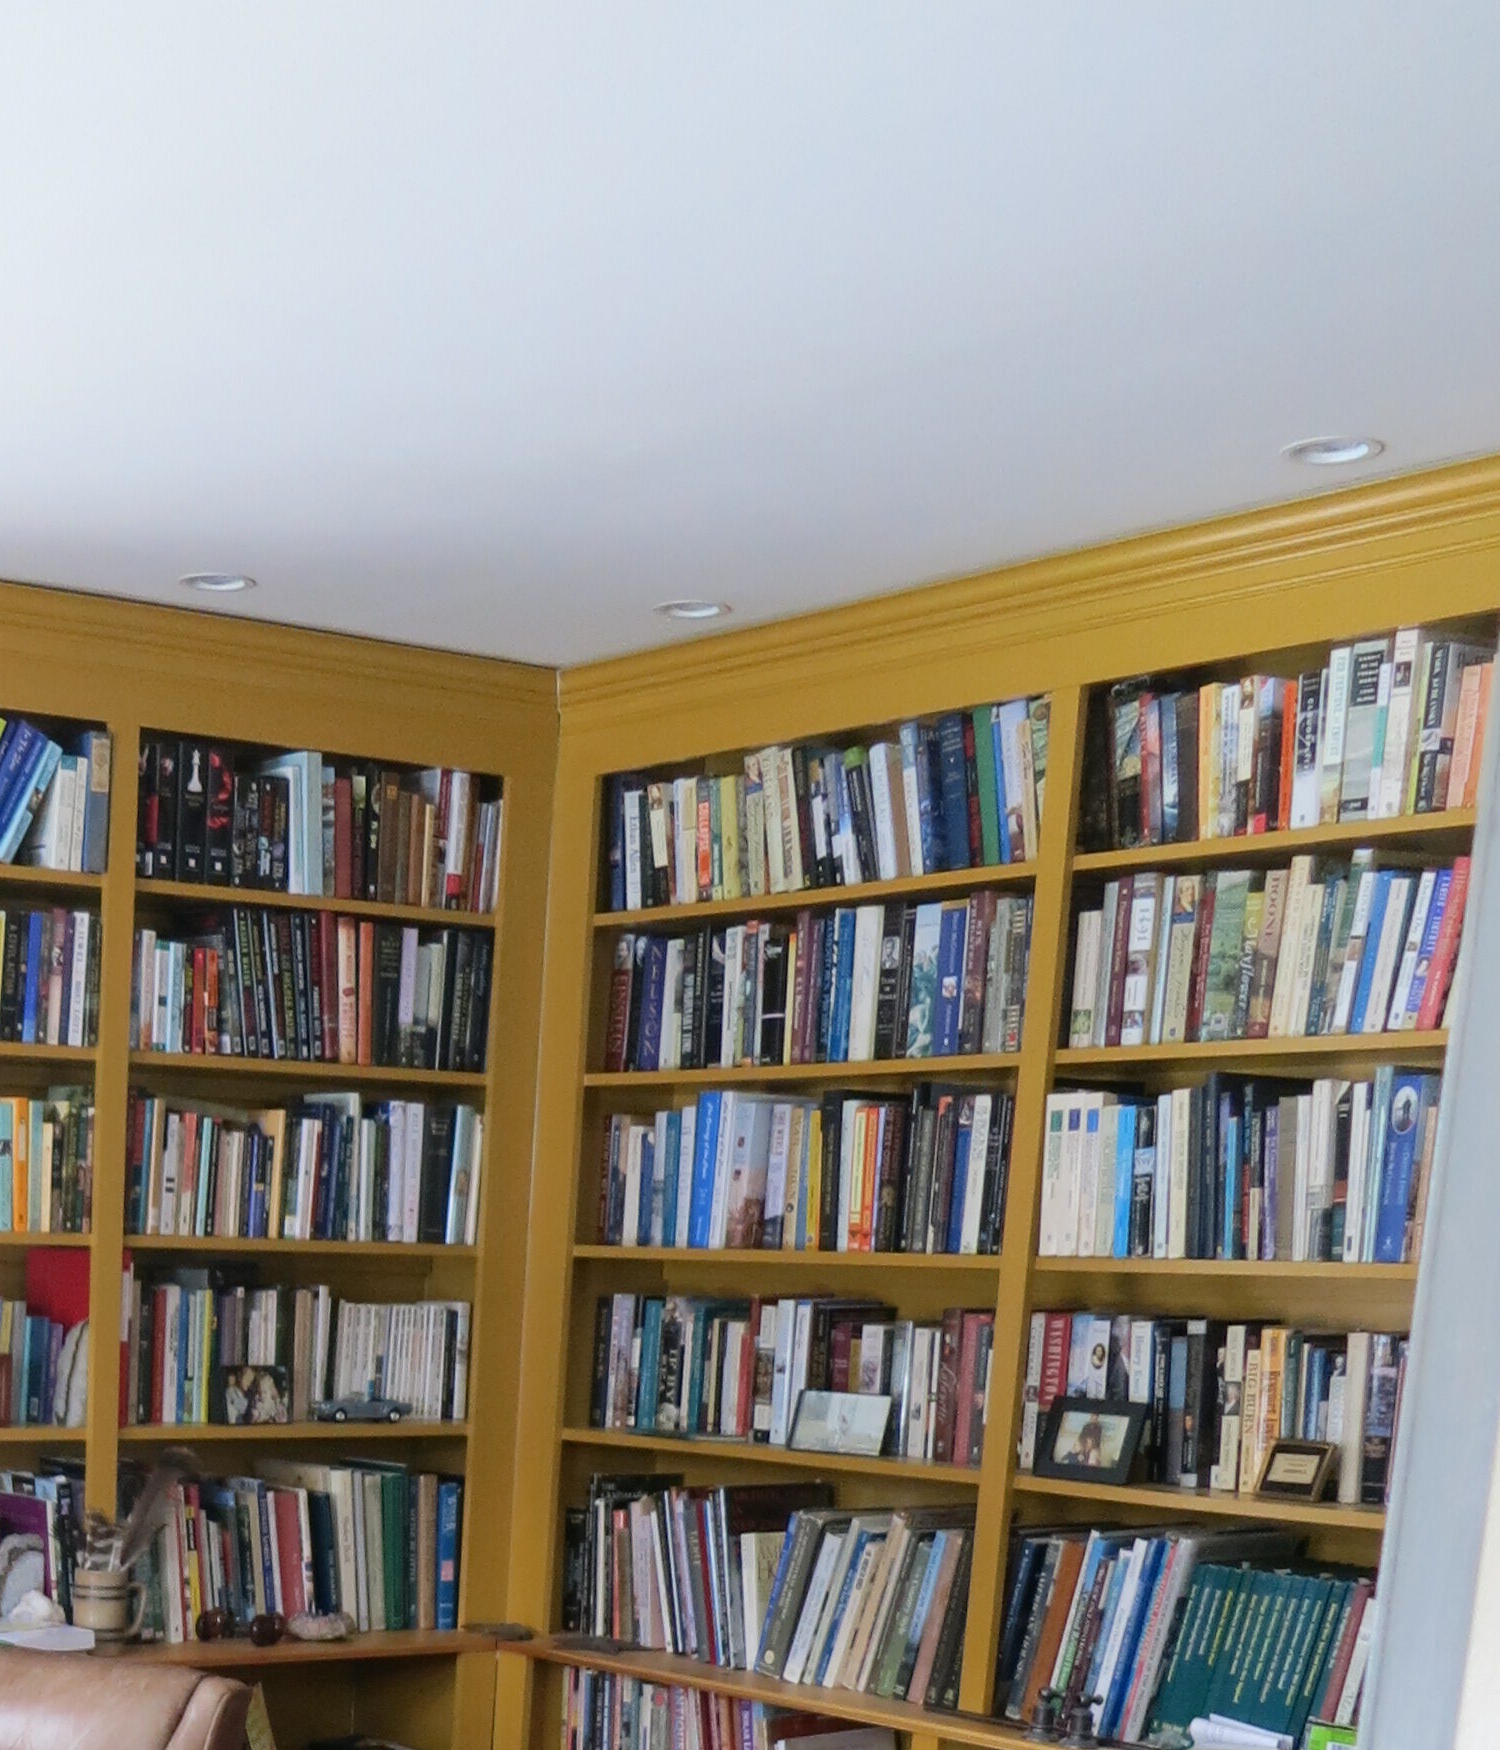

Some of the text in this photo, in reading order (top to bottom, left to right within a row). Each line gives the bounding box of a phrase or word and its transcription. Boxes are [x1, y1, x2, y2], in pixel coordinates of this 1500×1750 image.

[628, 849, 641, 875] Allen
[1042, 1318, 1063, 1402] WASHINGTON
[1242, 1361, 1258, 1436] BIG BURN
